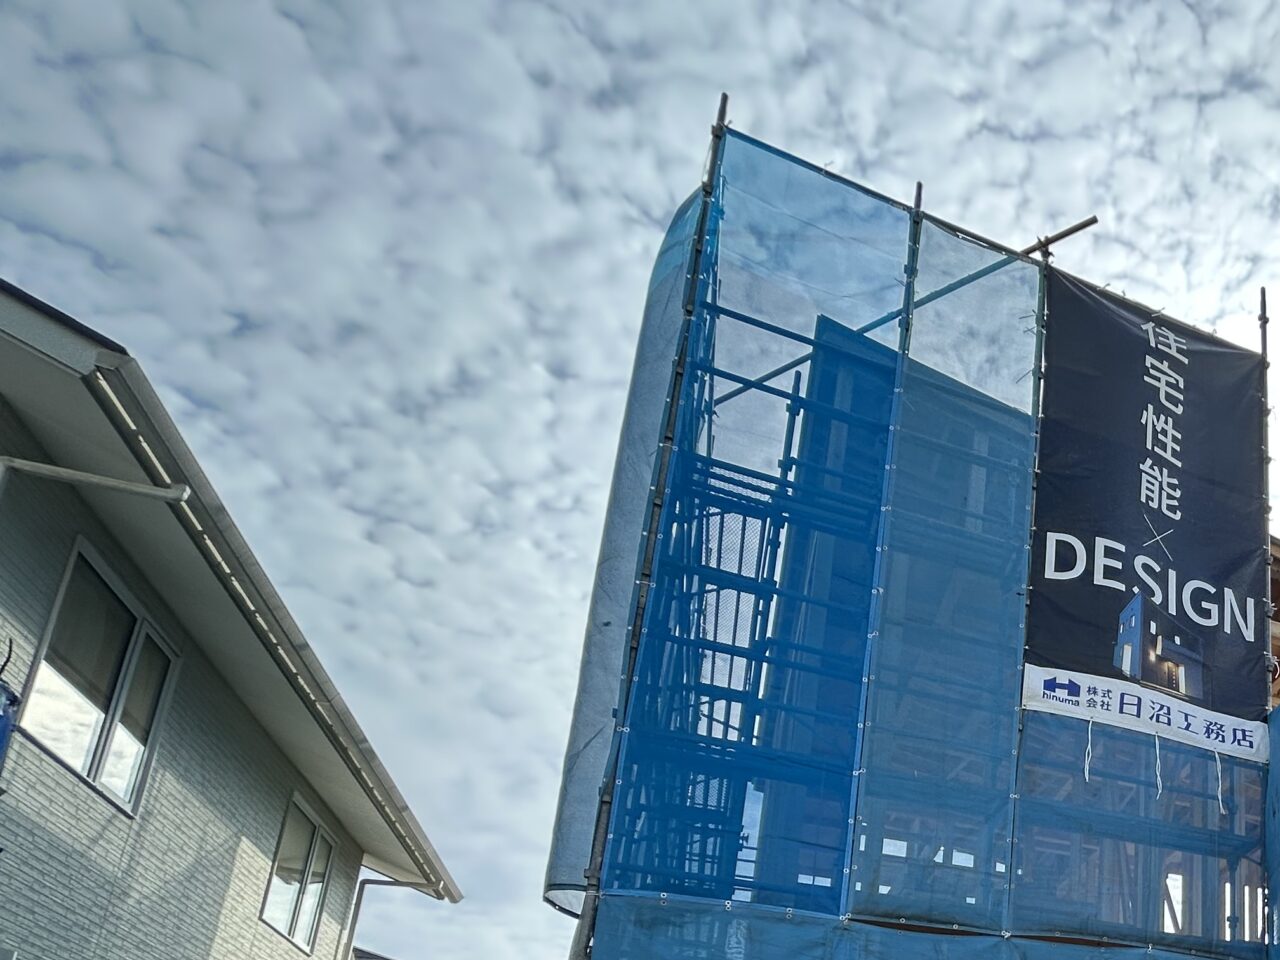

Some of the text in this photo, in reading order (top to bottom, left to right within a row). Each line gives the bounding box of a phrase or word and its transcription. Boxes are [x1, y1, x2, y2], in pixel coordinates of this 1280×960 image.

[1139, 321, 1189, 521] 住宅性能
[1044, 531, 1255, 643] DESIGN
[1042, 690, 1080, 707] hinuma
[1118, 692, 1254, 749] 日沼工務店
